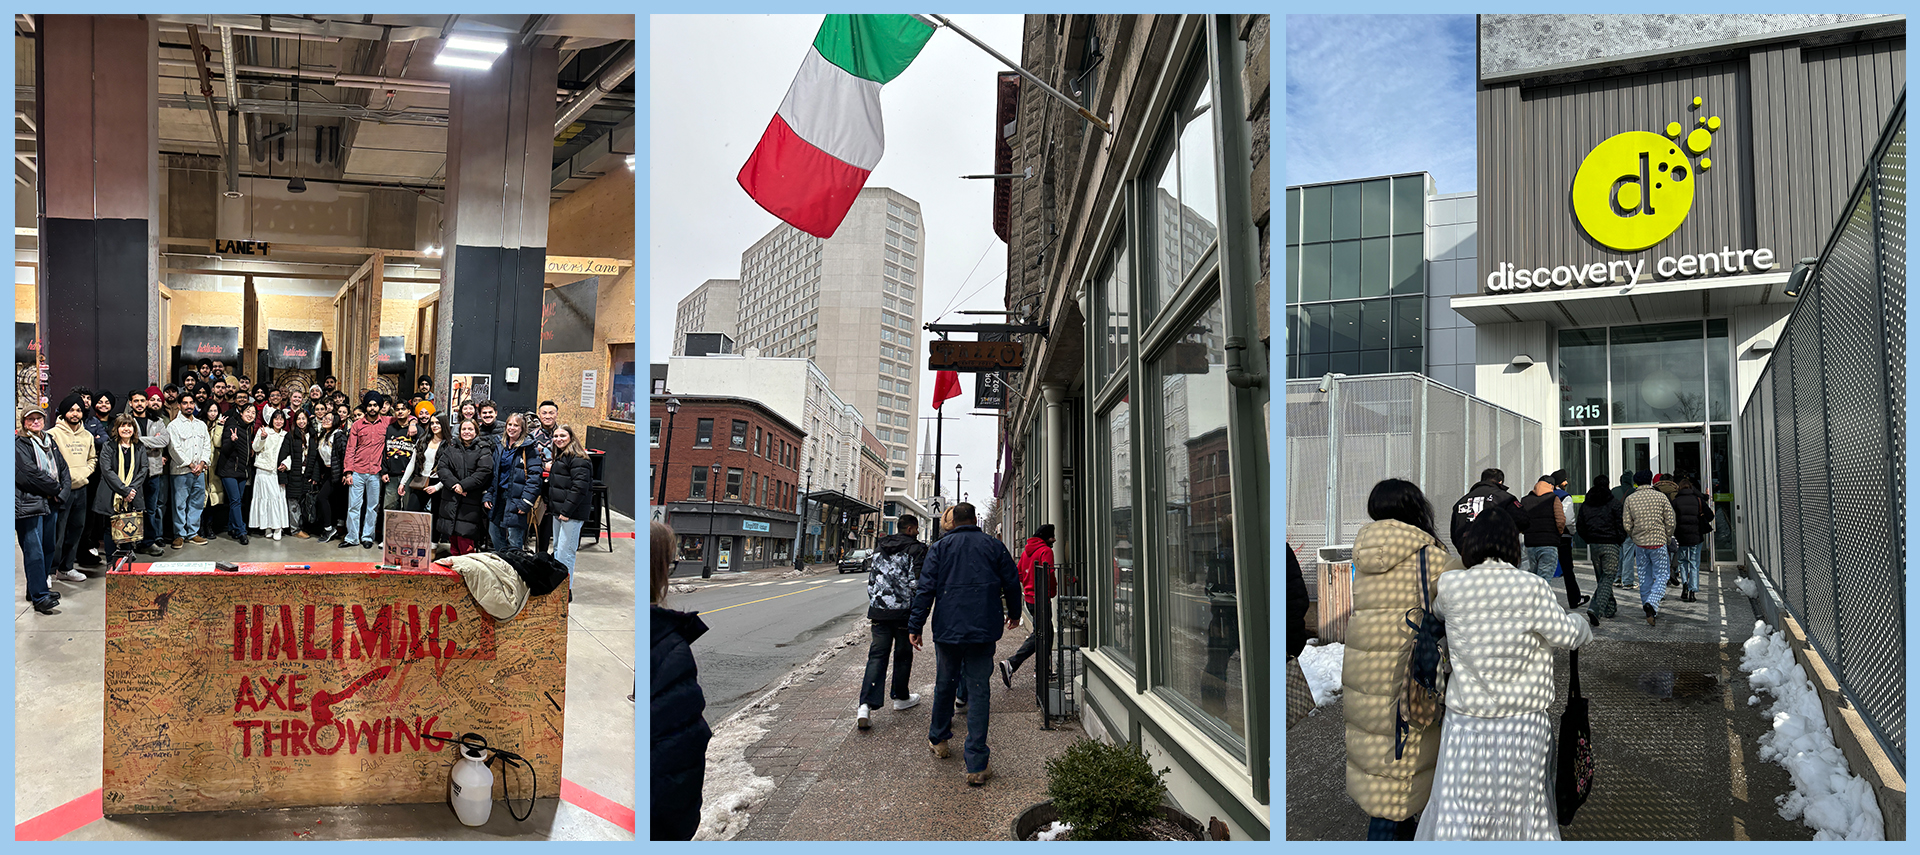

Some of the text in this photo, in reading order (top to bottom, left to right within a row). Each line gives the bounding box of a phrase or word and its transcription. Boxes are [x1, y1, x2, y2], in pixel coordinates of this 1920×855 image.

[1609, 152, 1656, 218] d
[215, 239, 270, 256] LANE 4
[548, 260, 618, 273] over's Lane
[1487, 245, 1774, 294] discovery centre
[936, 343, 1016, 364] PAZZO
[992, 379, 1000, 393] 902
[1568, 404, 1600, 419] 1215
[233, 604, 458, 661] HALIMAC
[234, 674, 308, 713] AXE
[232, 716, 453, 758] THROWING
